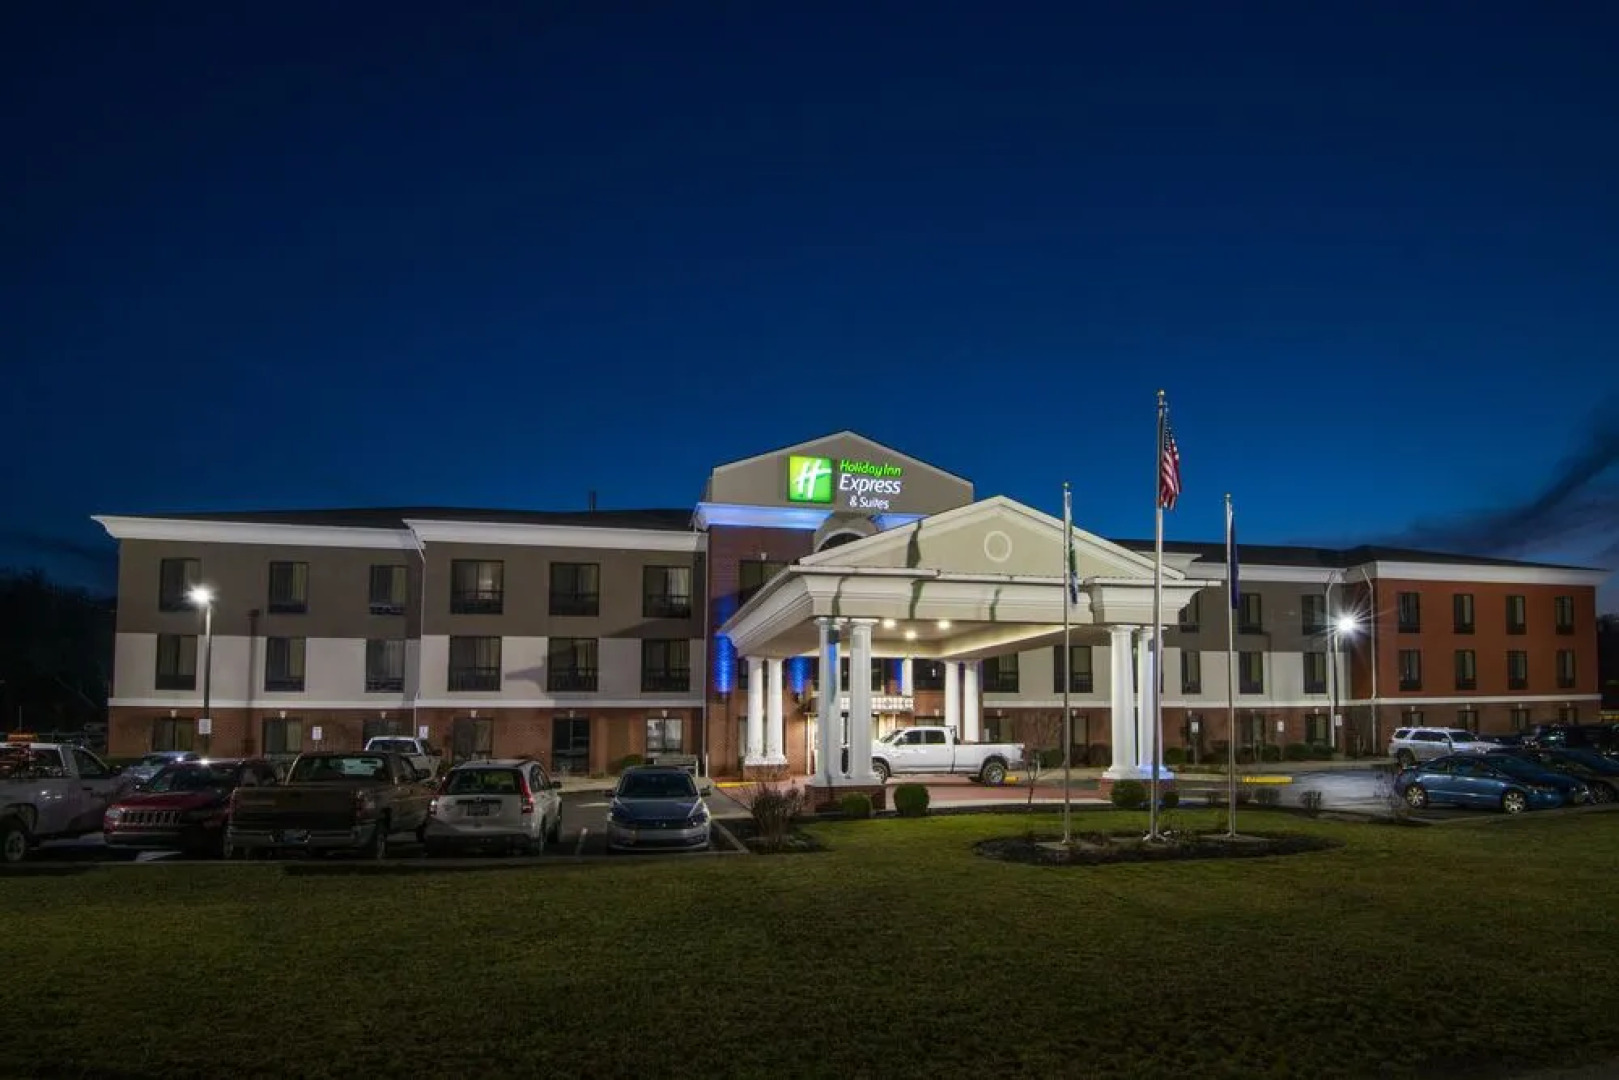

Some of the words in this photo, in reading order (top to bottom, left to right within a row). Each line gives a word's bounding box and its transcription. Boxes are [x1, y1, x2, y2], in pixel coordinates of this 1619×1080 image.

[839, 459, 883, 477] Holiday
[884, 463, 901, 477] Inn
[839, 473, 901, 495] Express
[849, 495, 858, 508] &
[859, 497, 890, 510] Suites
